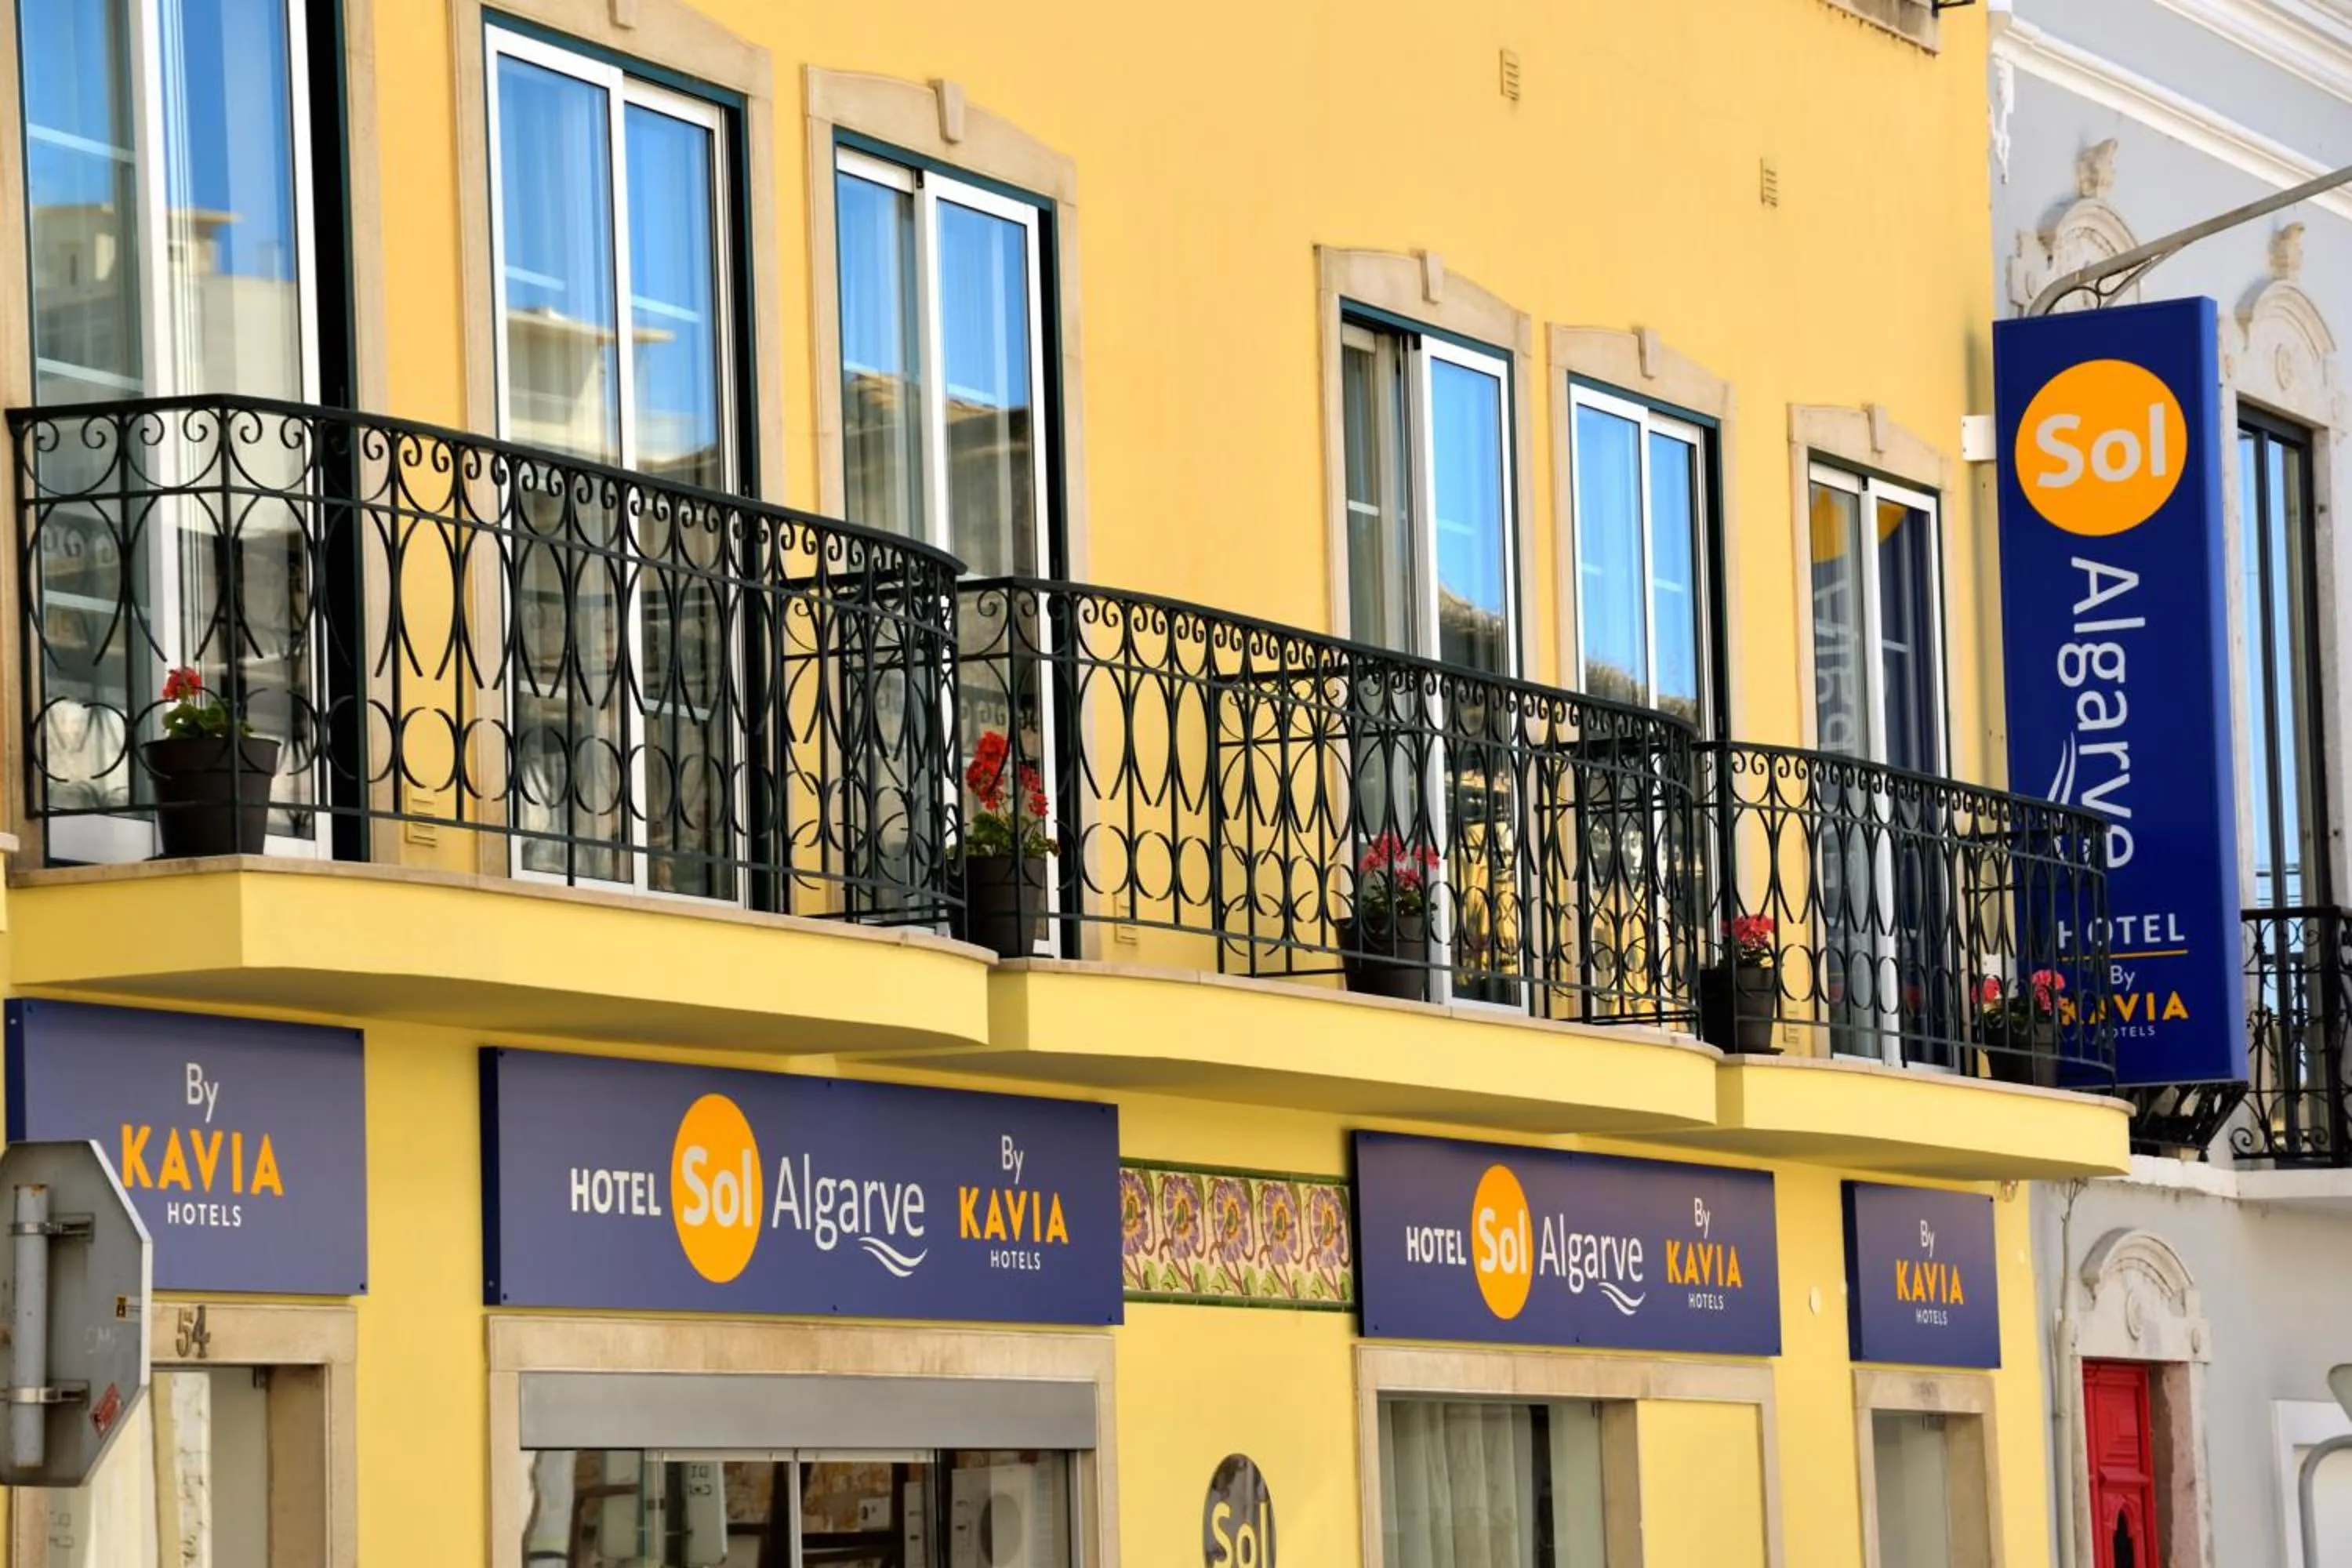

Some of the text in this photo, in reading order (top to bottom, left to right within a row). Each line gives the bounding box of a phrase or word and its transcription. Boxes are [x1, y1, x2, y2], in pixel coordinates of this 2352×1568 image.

[2035, 402, 2166, 488] Sol
[2057, 556, 2146, 869] Algarve
[2110, 965, 2136, 992] By
[185, 1062, 220, 1123] By
[120, 1123, 285, 1197] KAVIA
[1001, 1135, 1024, 1185] By
[166, 1202, 243, 1229] HOTELS
[570, 1146, 925, 1251] HOTEL Sol Algarve
[959, 1186, 1069, 1245] KAVIA
[1693, 1197, 1711, 1239] By
[990, 1250, 1041, 1271] HOTELS
[1406, 1207, 1643, 1294] HOTEL Sol Algarve
[1920, 1219, 1936, 1258] By
[1666, 1240, 1743, 1289] KAVIA
[1896, 1259, 1964, 1306] KAVIA
[1688, 1293, 1725, 1312] HOTELS
[1915, 1308, 1948, 1326] HOTELS
[175, 1305, 212, 1359] 54
[1212, 1501, 1269, 1568] Sol
